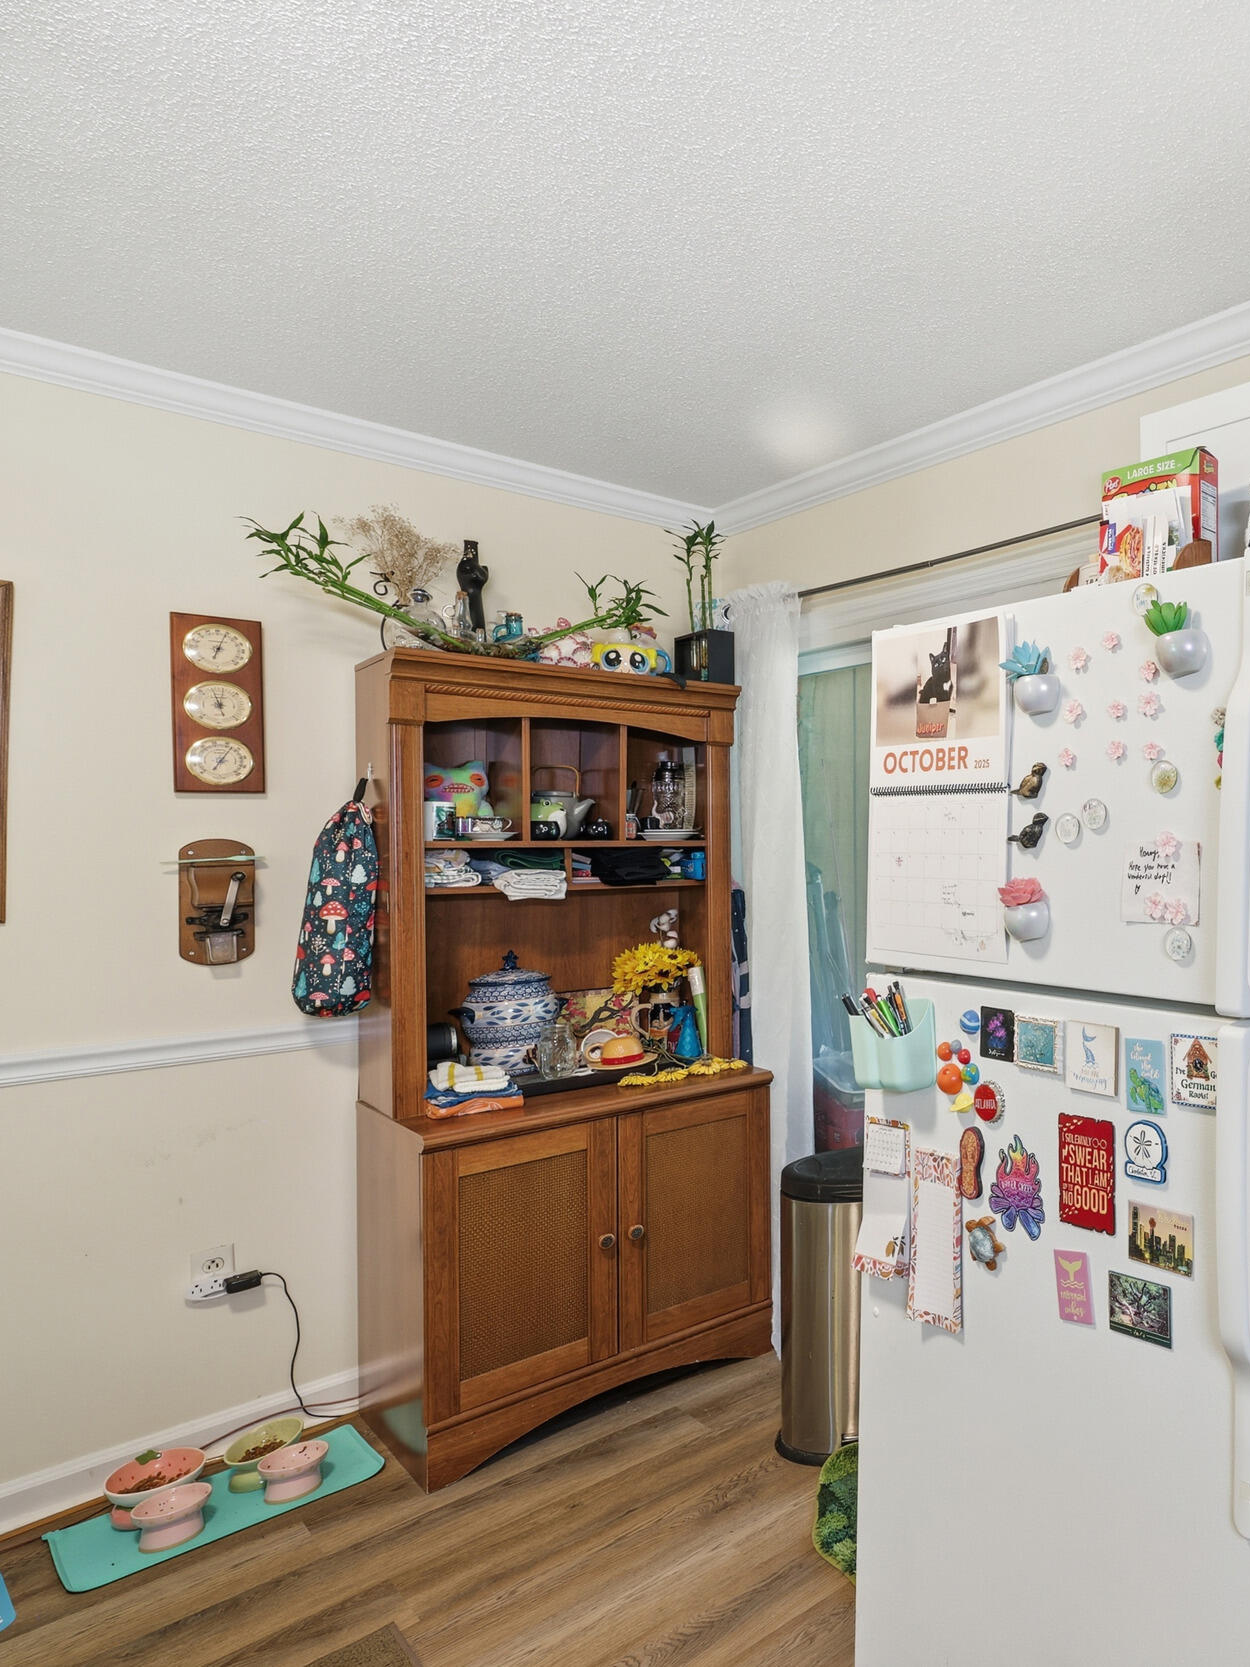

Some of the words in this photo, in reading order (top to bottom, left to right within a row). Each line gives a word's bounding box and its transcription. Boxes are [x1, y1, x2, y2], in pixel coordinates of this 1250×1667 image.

[1127, 466, 1154, 480] LARGE
[1157, 460, 1176, 471] SIZE
[1106, 479, 1119, 491] Post
[883, 746, 969, 775] OCTOBER
[974, 759, 990, 769] 2025
[1176, 1067, 1186, 1075] I've
[1181, 1079, 1216, 1092] German
[1065, 1133, 1092, 1147] SOLEMNLY
[1069, 1144, 1107, 1171] SWEAR
[1062, 1163, 1087, 1186] THAT
[1062, 1190, 1073, 1206] NO
[1073, 1185, 1108, 1215] GOOD
